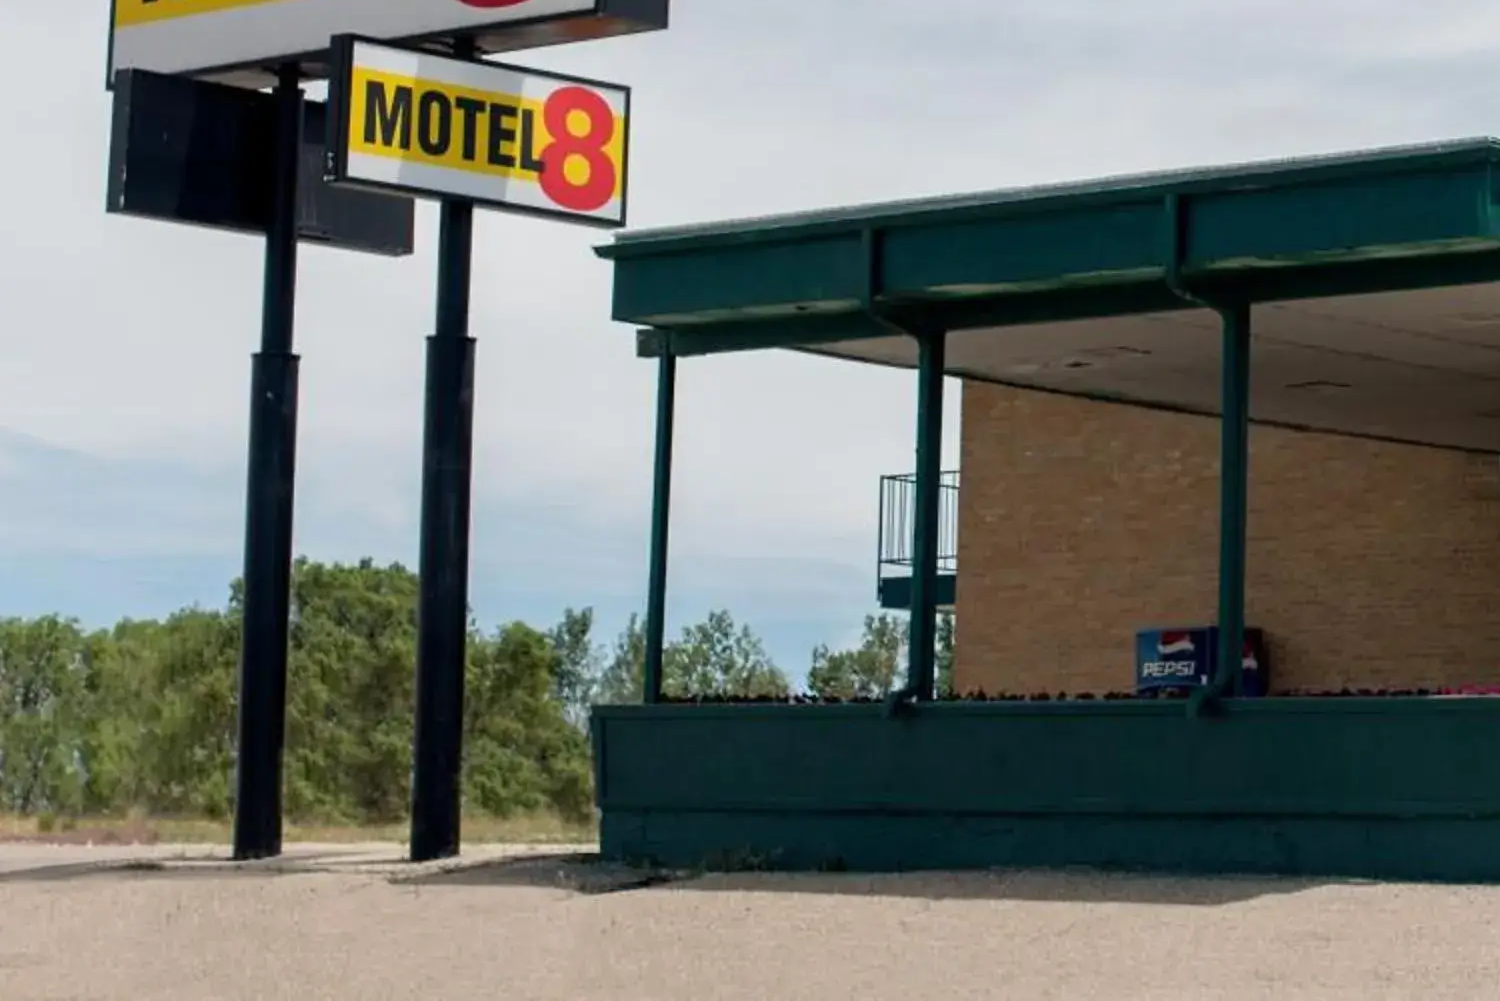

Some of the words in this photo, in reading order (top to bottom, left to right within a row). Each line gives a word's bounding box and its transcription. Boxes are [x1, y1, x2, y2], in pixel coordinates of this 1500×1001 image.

[362, 79, 546, 174] MOTEL
[537, 85, 617, 212] 8
[1142, 660, 1196, 678] PEPSI
